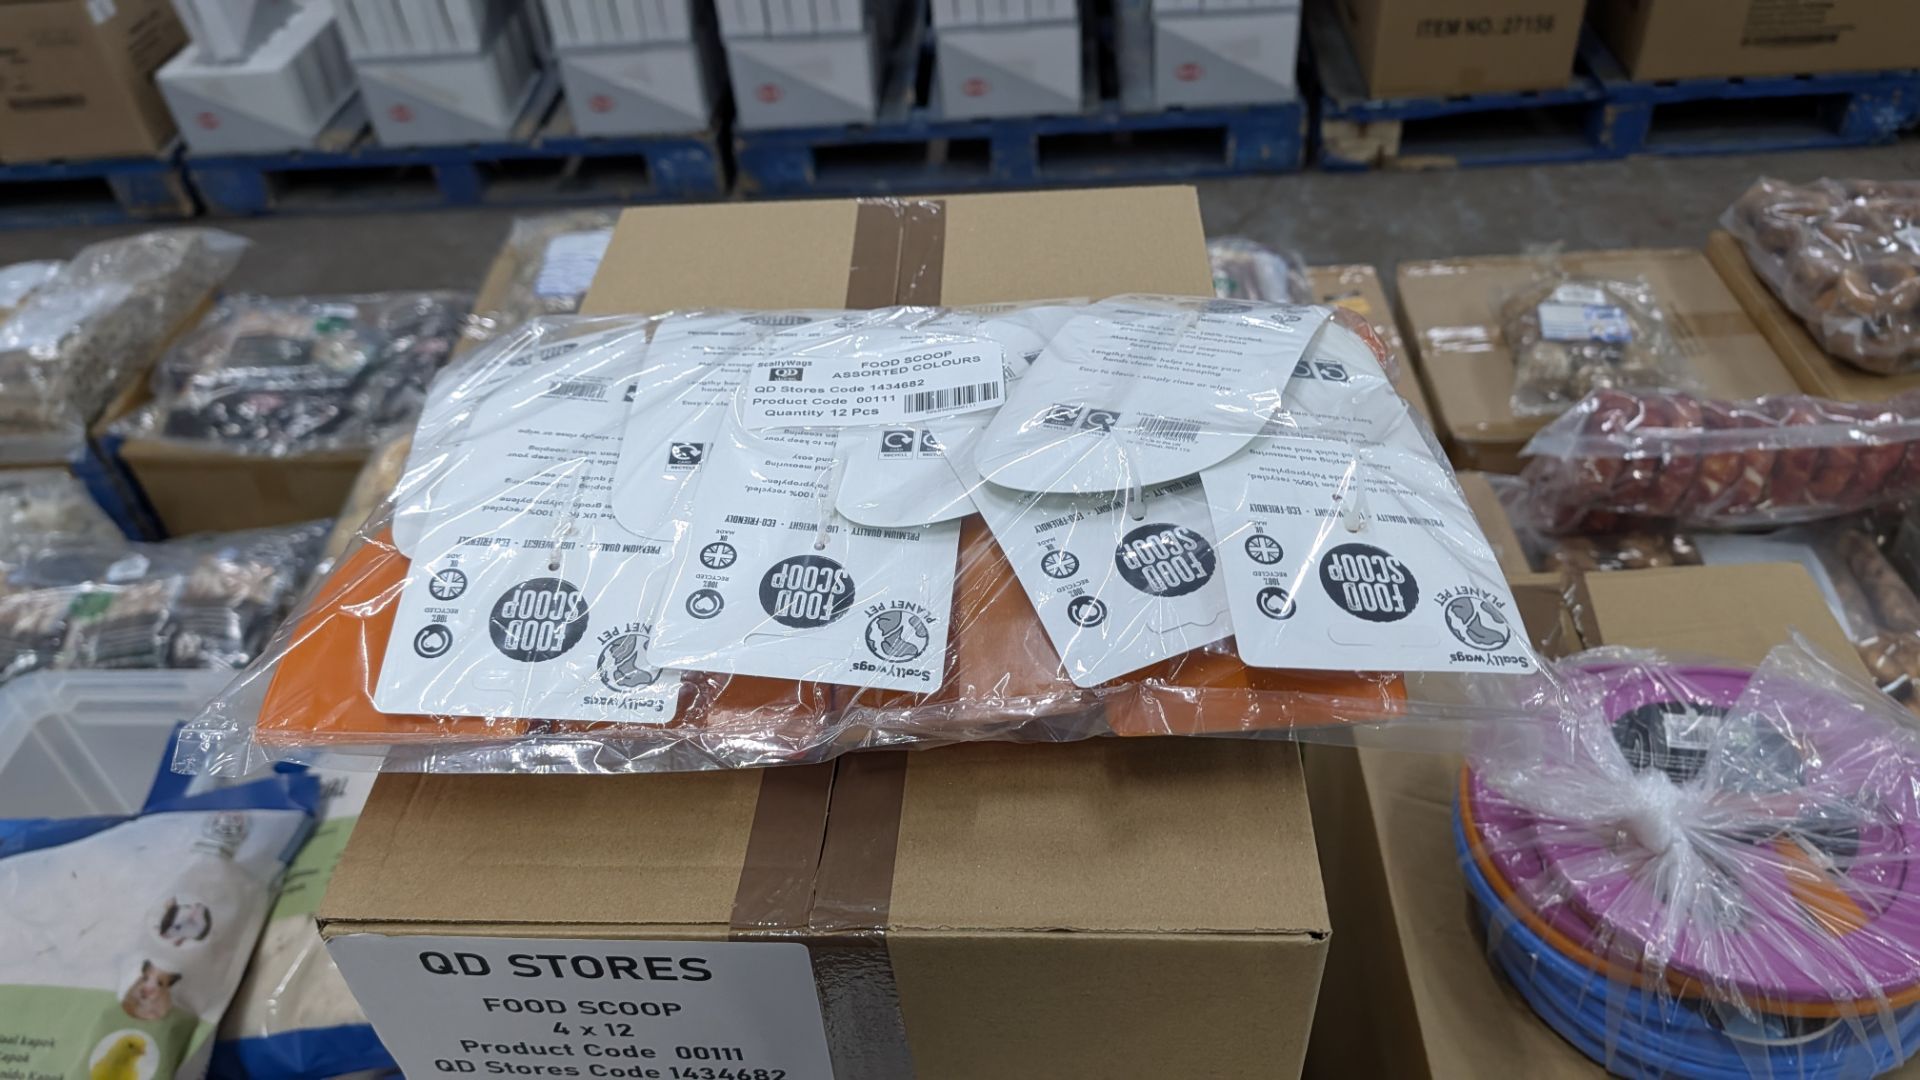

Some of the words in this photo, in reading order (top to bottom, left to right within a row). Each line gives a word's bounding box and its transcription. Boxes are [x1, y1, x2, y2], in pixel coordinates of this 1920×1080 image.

[832, 367, 907, 379] ASSORTED
[912, 355, 981, 373] COLOURS
[861, 359, 901, 369] FOOD
[904, 350, 952, 364] SCOOP
[754, 385, 776, 394] QD
[781, 385, 825, 394] Stores
[829, 384, 865, 393] Code
[870, 379, 925, 391] 1434682
[753, 397, 808, 406] Product
[812, 396, 847, 405] Code
[856, 395, 895, 404] 00111
[765, 408, 824, 418] Quantity
[852, 407, 879, 416] Pcs
[764, 460, 813, 469] measuring
[792, 453, 814, 462] easy
[1247, 472, 1290, 484] recycled,
[1293, 479, 1319, 488] 100%
[1249, 503, 1302, 516] ECO-FRIENDLY
[725, 514, 777, 527] ECO-FRIENDLY
[1376, 513, 1408, 526] QUALITY
[851, 526, 882, 538] QUALITY
[883, 530, 920, 541] PREMIUM
[1118, 526, 1198, 571] SCOOP
[695, 573, 730, 582] RECYCLED
[1141, 551, 1207, 593] FOOD
[1252, 570, 1287, 578] RECYCLED
[1327, 553, 1404, 584] SCOOP
[771, 563, 848, 594] SCOOP
[501, 588, 582, 620] SCOOP
[774, 590, 835, 621] FOOD
[1341, 582, 1405, 613] FOOD
[1433, 588, 1451, 606] PET
[1453, 585, 1506, 610] PLANET
[863, 600, 886, 617] PET
[890, 600, 937, 624] PLANET
[505, 619, 566, 652] FOOD
[418, 951, 490, 976] QD
[513, 954, 713, 983] STORES
[482, 997, 568, 1014] FOOD
[578, 999, 682, 1017] SCOOP
[552, 1022, 570, 1036] 4
[581, 1025, 598, 1036] x
[605, 1022, 635, 1037] 12
[461, 1039, 575, 1057] Product
[582, 1043, 657, 1060] Code
[675, 1046, 744, 1061] 00111
[434, 1058, 475, 1074] QD
[487, 1060, 578, 1078] Stores
[586, 1063, 661, 1080] Code
[669, 1066, 786, 1080] 1434682
